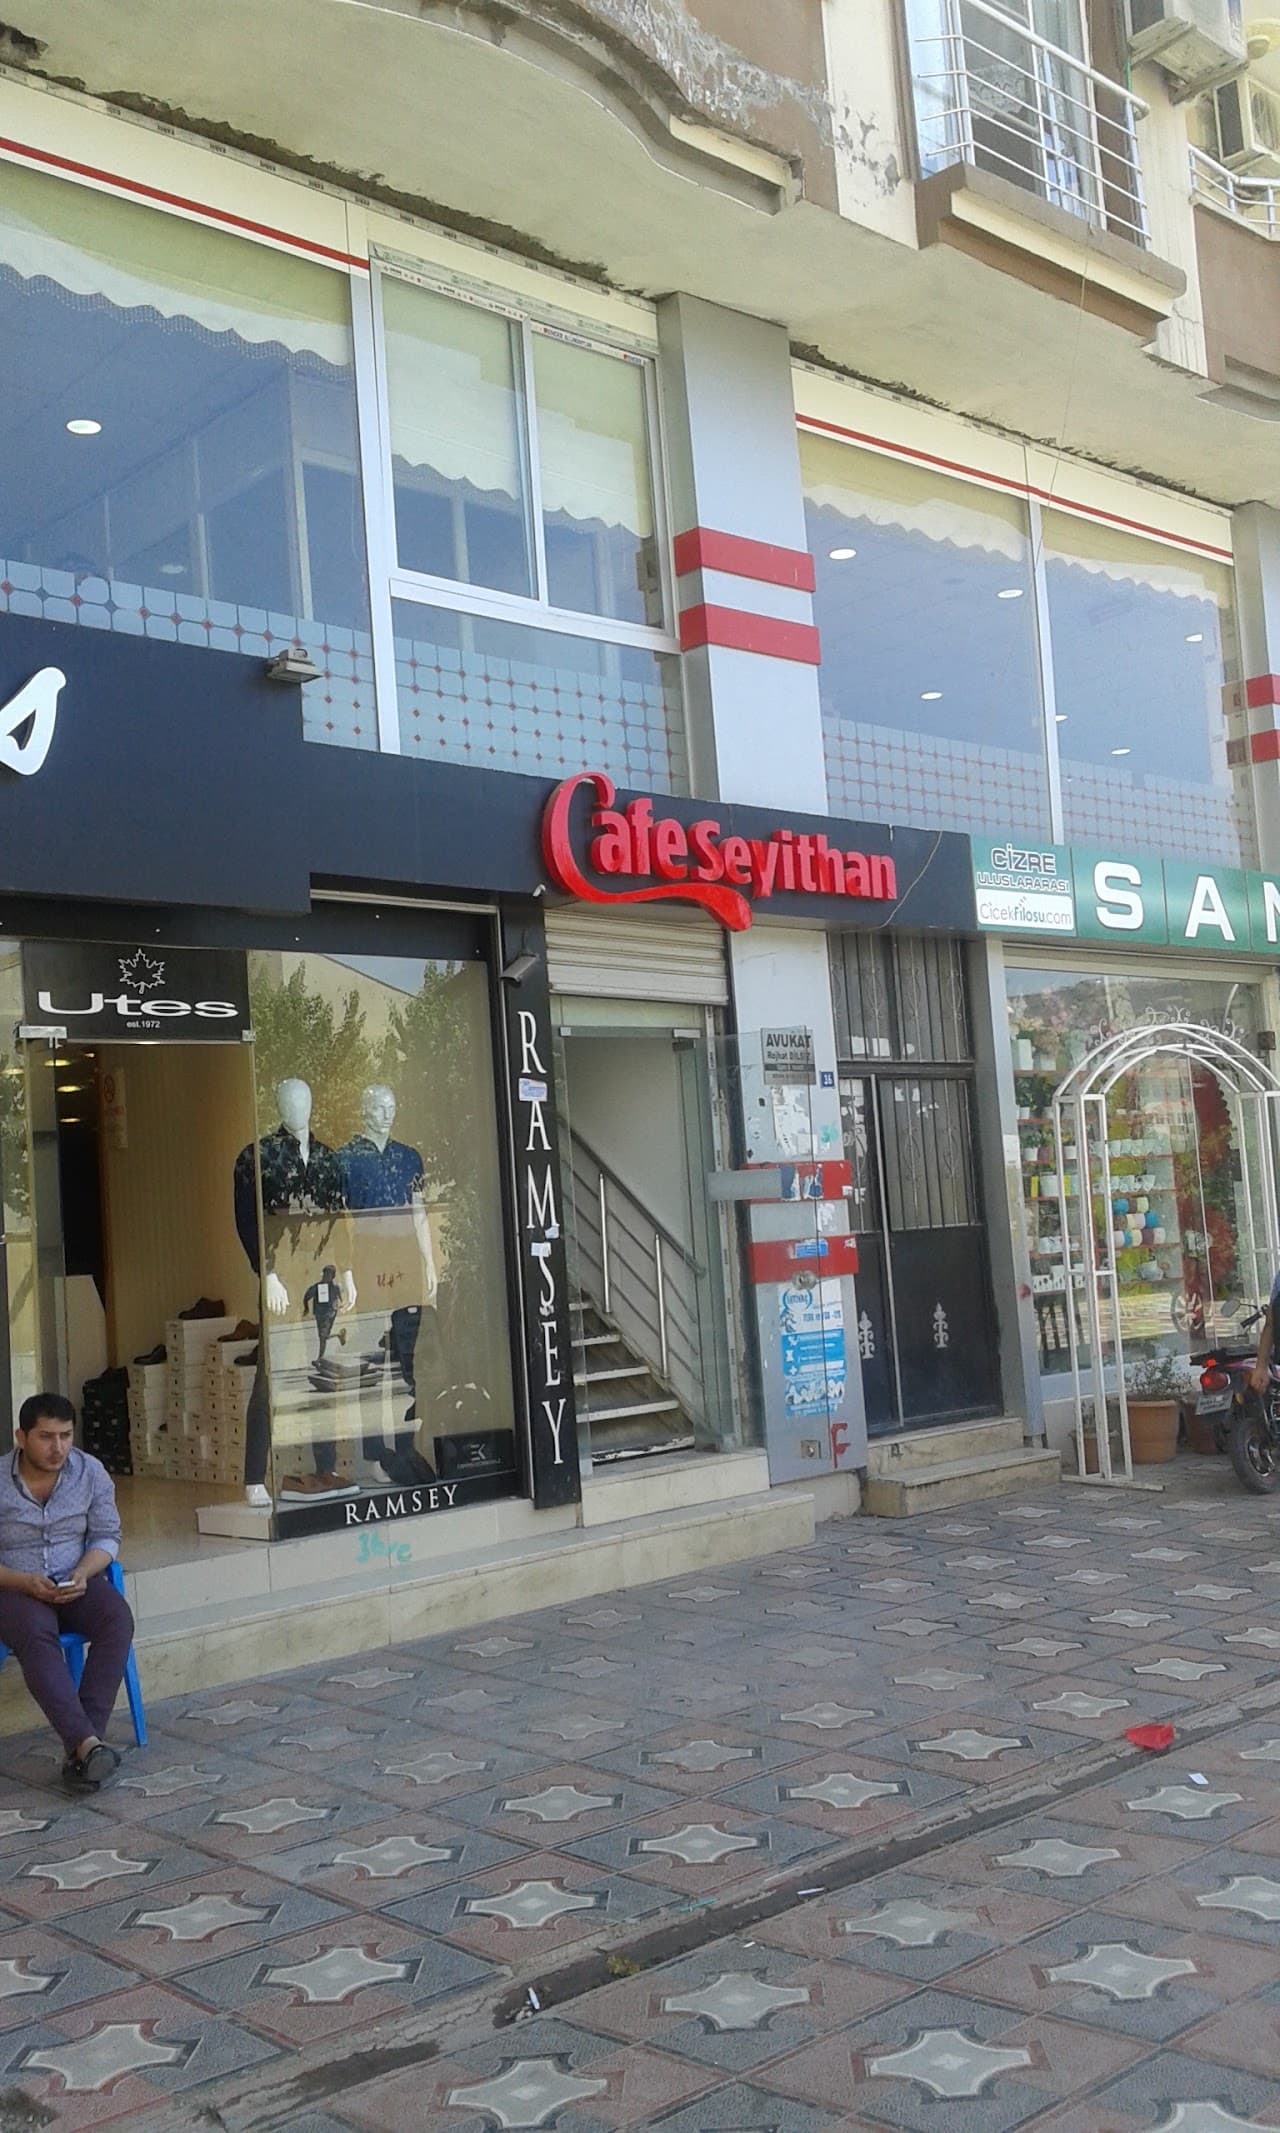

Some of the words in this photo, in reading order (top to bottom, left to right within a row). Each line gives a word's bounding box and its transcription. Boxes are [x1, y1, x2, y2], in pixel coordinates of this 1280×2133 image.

[541, 771, 690, 905] Cafe
[688, 819, 898, 900] Seyithan
[991, 843, 1057, 875] CİZRE
[977, 871, 1071, 892] ULUSLARARASI
[38, 991, 239, 1018] Utes
[126, 1019, 161, 1029] est.1972
[766, 1033, 812, 1049] AVUKAT
[518, 1010, 567, 1465] RAMSEY
[344, 1484, 459, 1525] RAMSEY
